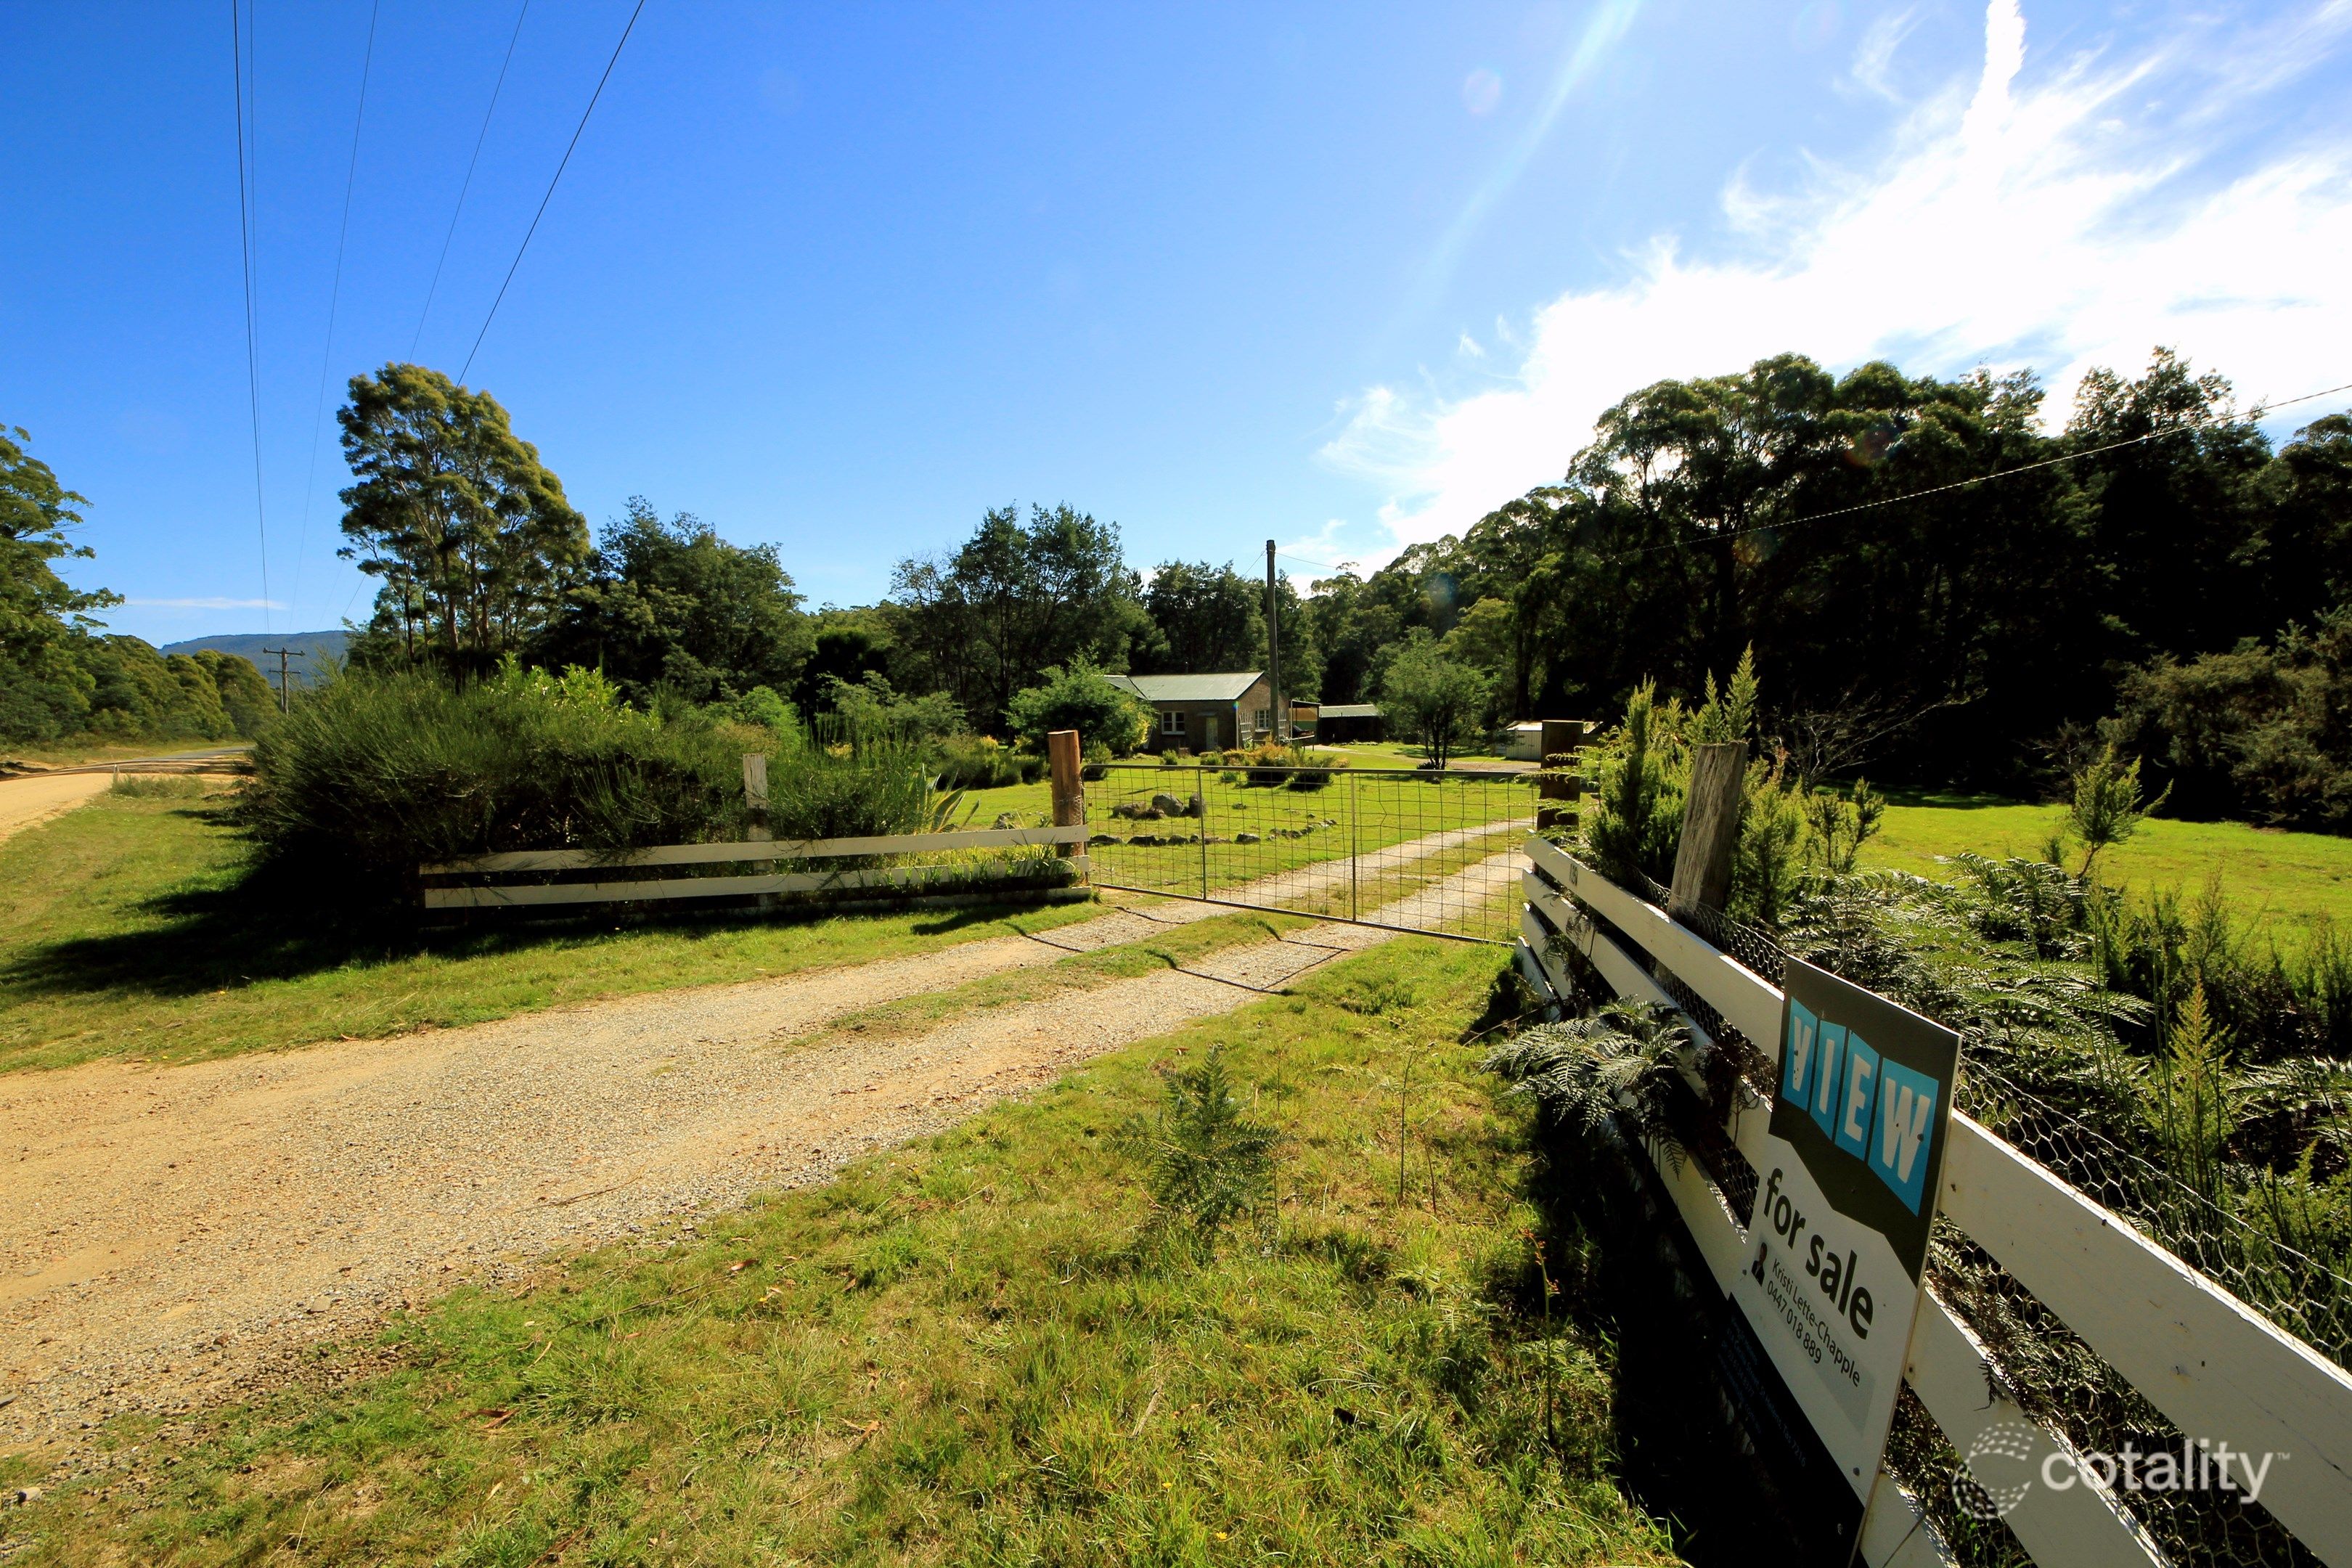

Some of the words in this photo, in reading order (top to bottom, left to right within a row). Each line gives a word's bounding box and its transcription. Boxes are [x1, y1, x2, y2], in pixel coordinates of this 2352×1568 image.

[1792, 1016, 1931, 1184] VIEW
[1763, 1167, 1806, 1249] for
[1805, 1234, 1874, 1340] sale
[1767, 1281, 1788, 1315] 0447
[1787, 1310, 1803, 1338] 018
[1802, 1334, 1822, 1364] 889
[1773, 1258, 1793, 1295] Kristi
[1792, 1285, 1861, 1388] Lette-Chapple
